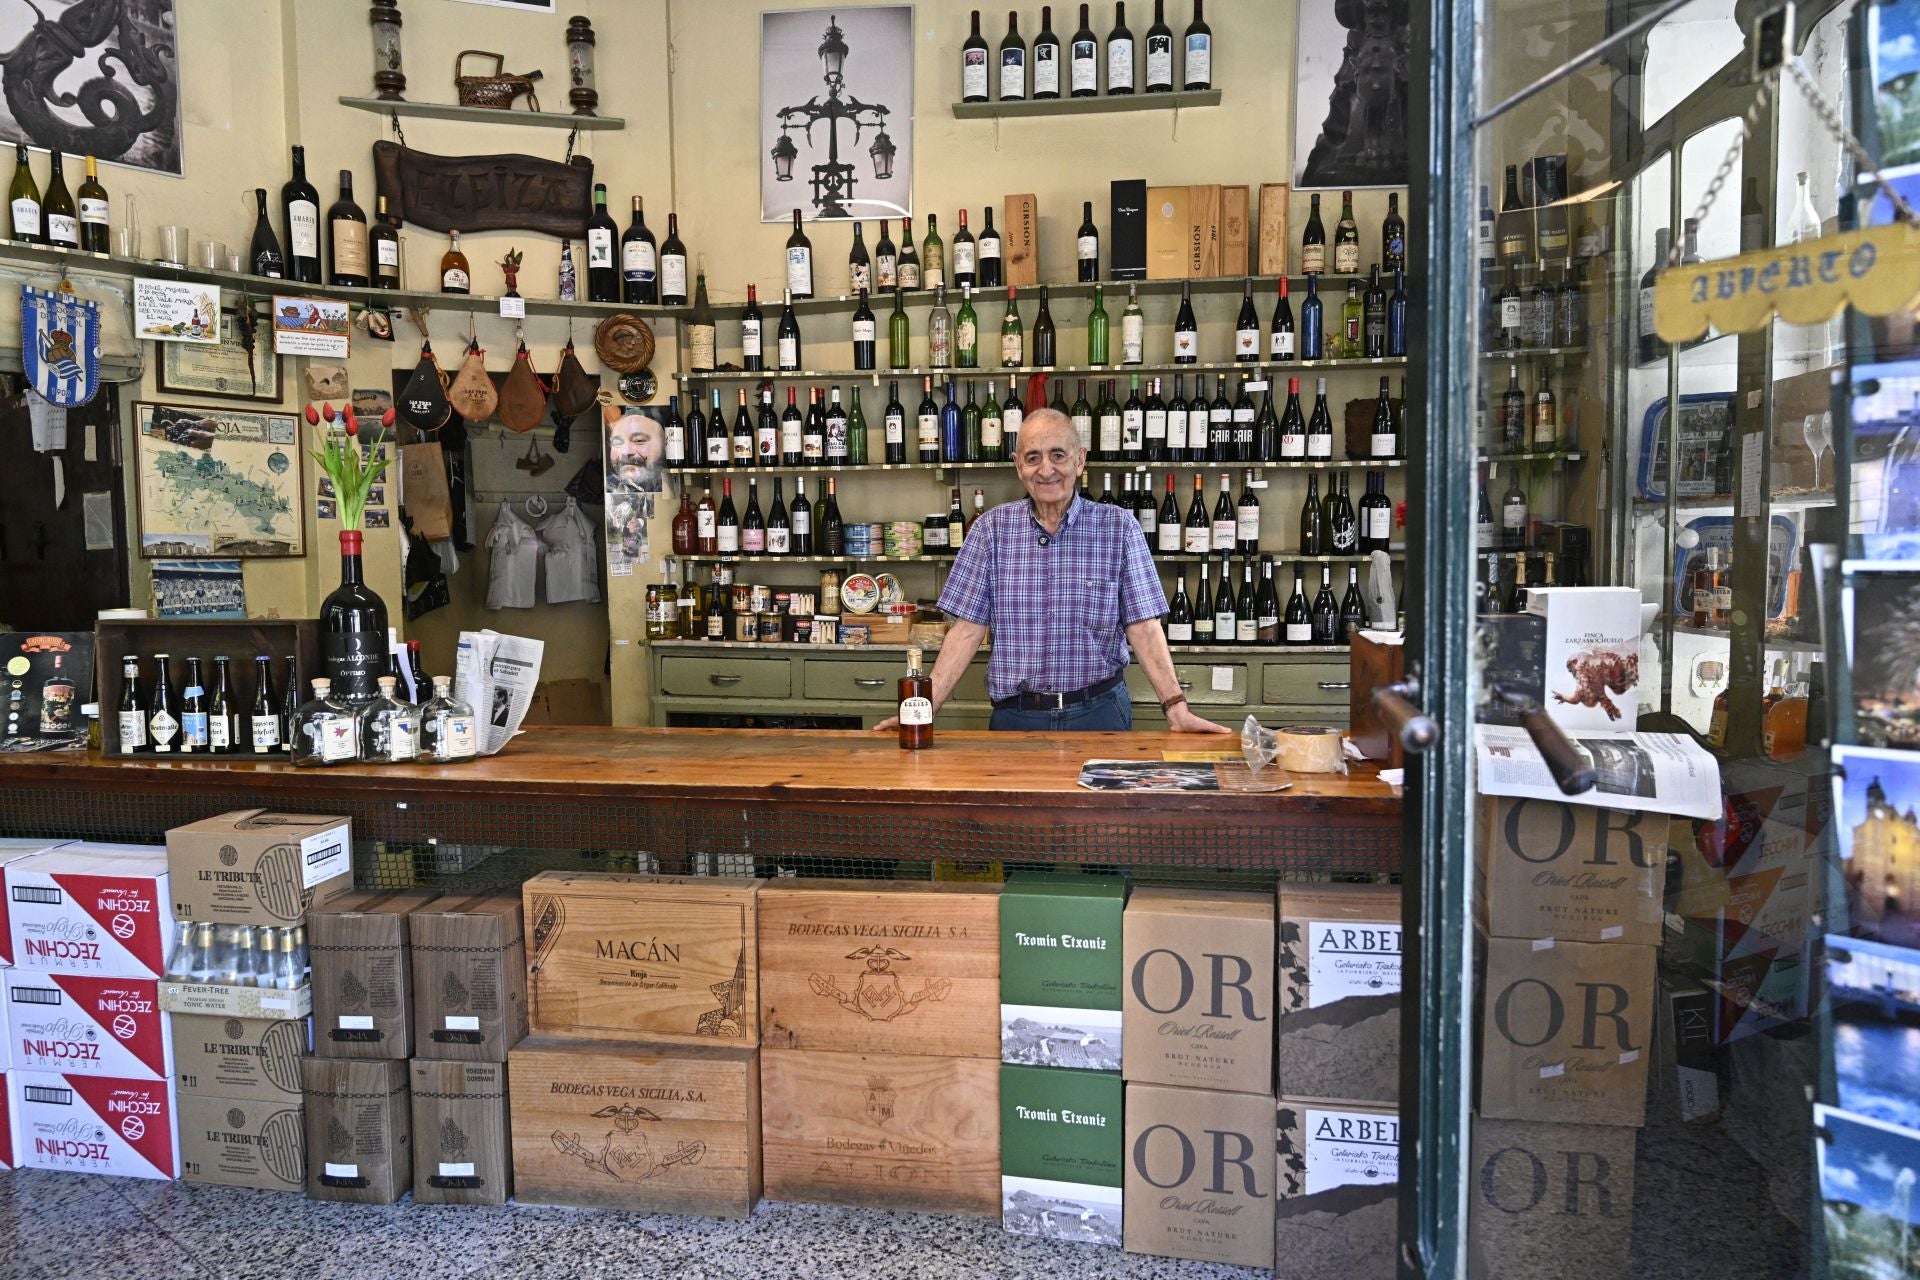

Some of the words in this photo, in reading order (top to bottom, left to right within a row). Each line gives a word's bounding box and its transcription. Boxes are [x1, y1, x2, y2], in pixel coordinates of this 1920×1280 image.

[1022, 201, 1030, 247] CIRSION
[1193, 225, 1201, 271] CIRSION
[1211, 430, 1230, 443] CAIR
[1234, 430, 1253, 443] CAIR
[1504, 800, 1659, 869] OR
[198, 870, 212, 881] LE
[216, 871, 262, 884] TRIBUTE
[98, 898, 151, 912] ZECCHINI
[1539, 905, 1568, 914] BRUT
[1574, 907, 1619, 916] NATURE
[788, 923, 850, 936] BODEGAS
[854, 924, 888, 937] VEGA
[25, 939, 101, 960] ZECCHINI
[595, 936, 681, 963] MACÁN
[1016, 932, 1057, 947] Txomin
[1061, 934, 1107, 950] Etxaniz
[25, 957, 102, 969] VERMUT
[630, 969, 648, 979] Rioja
[182, 985, 230, 995] FEVER-TREE
[1131, 948, 1266, 1021] OR
[98, 1000, 152, 1013] ZECCHINI
[183, 1001, 203, 1009] TONIC
[1494, 978, 1643, 1051] OR
[1193, 1023, 1243, 1041] Rossell
[1684, 1008, 1710, 1044] KIT
[22, 1039, 101, 1060] ZECCHINI
[204, 1042, 218, 1054] LE
[219, 1043, 268, 1057] TRIBUTE
[1164, 1052, 1191, 1062] BRUT
[1195, 1055, 1236, 1065] NATURE
[26, 1057, 102, 1069] VERMUT
[550, 1082, 605, 1096] BODEGAS
[607, 1085, 635, 1098] VEGA
[686, 1090, 706, 1102] S.A.
[108, 1100, 161, 1114] ZECCHINI
[1016, 1105, 1057, 1122] Txomin
[1061, 1109, 1106, 1127] Etxaniz
[207, 1130, 220, 1142] LE
[222, 1132, 269, 1148] TRIBUTE
[557, 1133, 588, 1159] MARCA
[826, 1137, 875, 1152] Bodegas
[35, 1137, 110, 1160] ZECCHINI
[34, 1156, 111, 1168] VERMUT
[1132, 1124, 1268, 1198] OR
[1480, 1147, 1625, 1219] OR
[1193, 1198, 1244, 1216] Rossell
[1166, 1226, 1192, 1235] BRUT
[1196, 1229, 1237, 1239] NATURE
